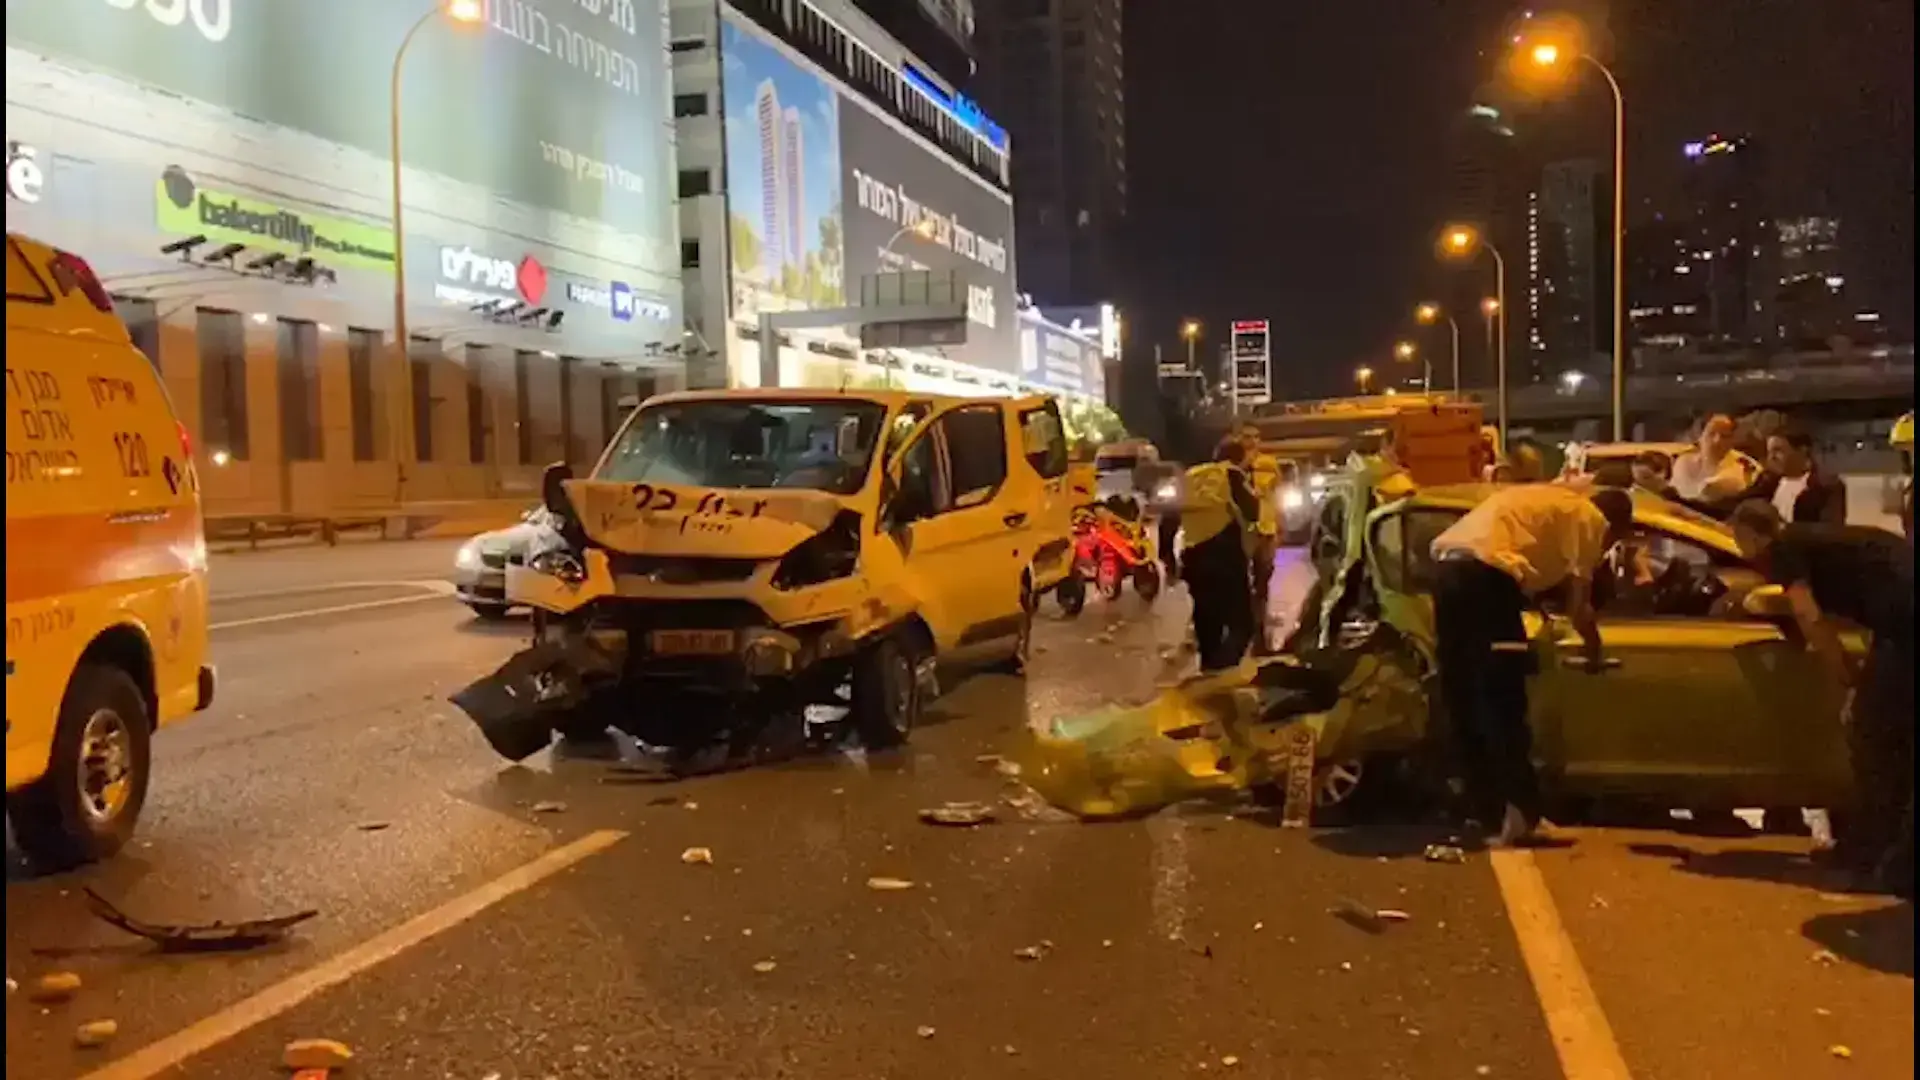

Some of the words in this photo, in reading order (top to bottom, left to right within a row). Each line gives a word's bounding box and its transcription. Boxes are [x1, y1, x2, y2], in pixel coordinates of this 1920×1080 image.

[556, 23, 640, 96] הפתיחה
[24, 368, 61, 405] מגן
[20, 409, 75, 442] אדום
[113, 431, 150, 478] 120
